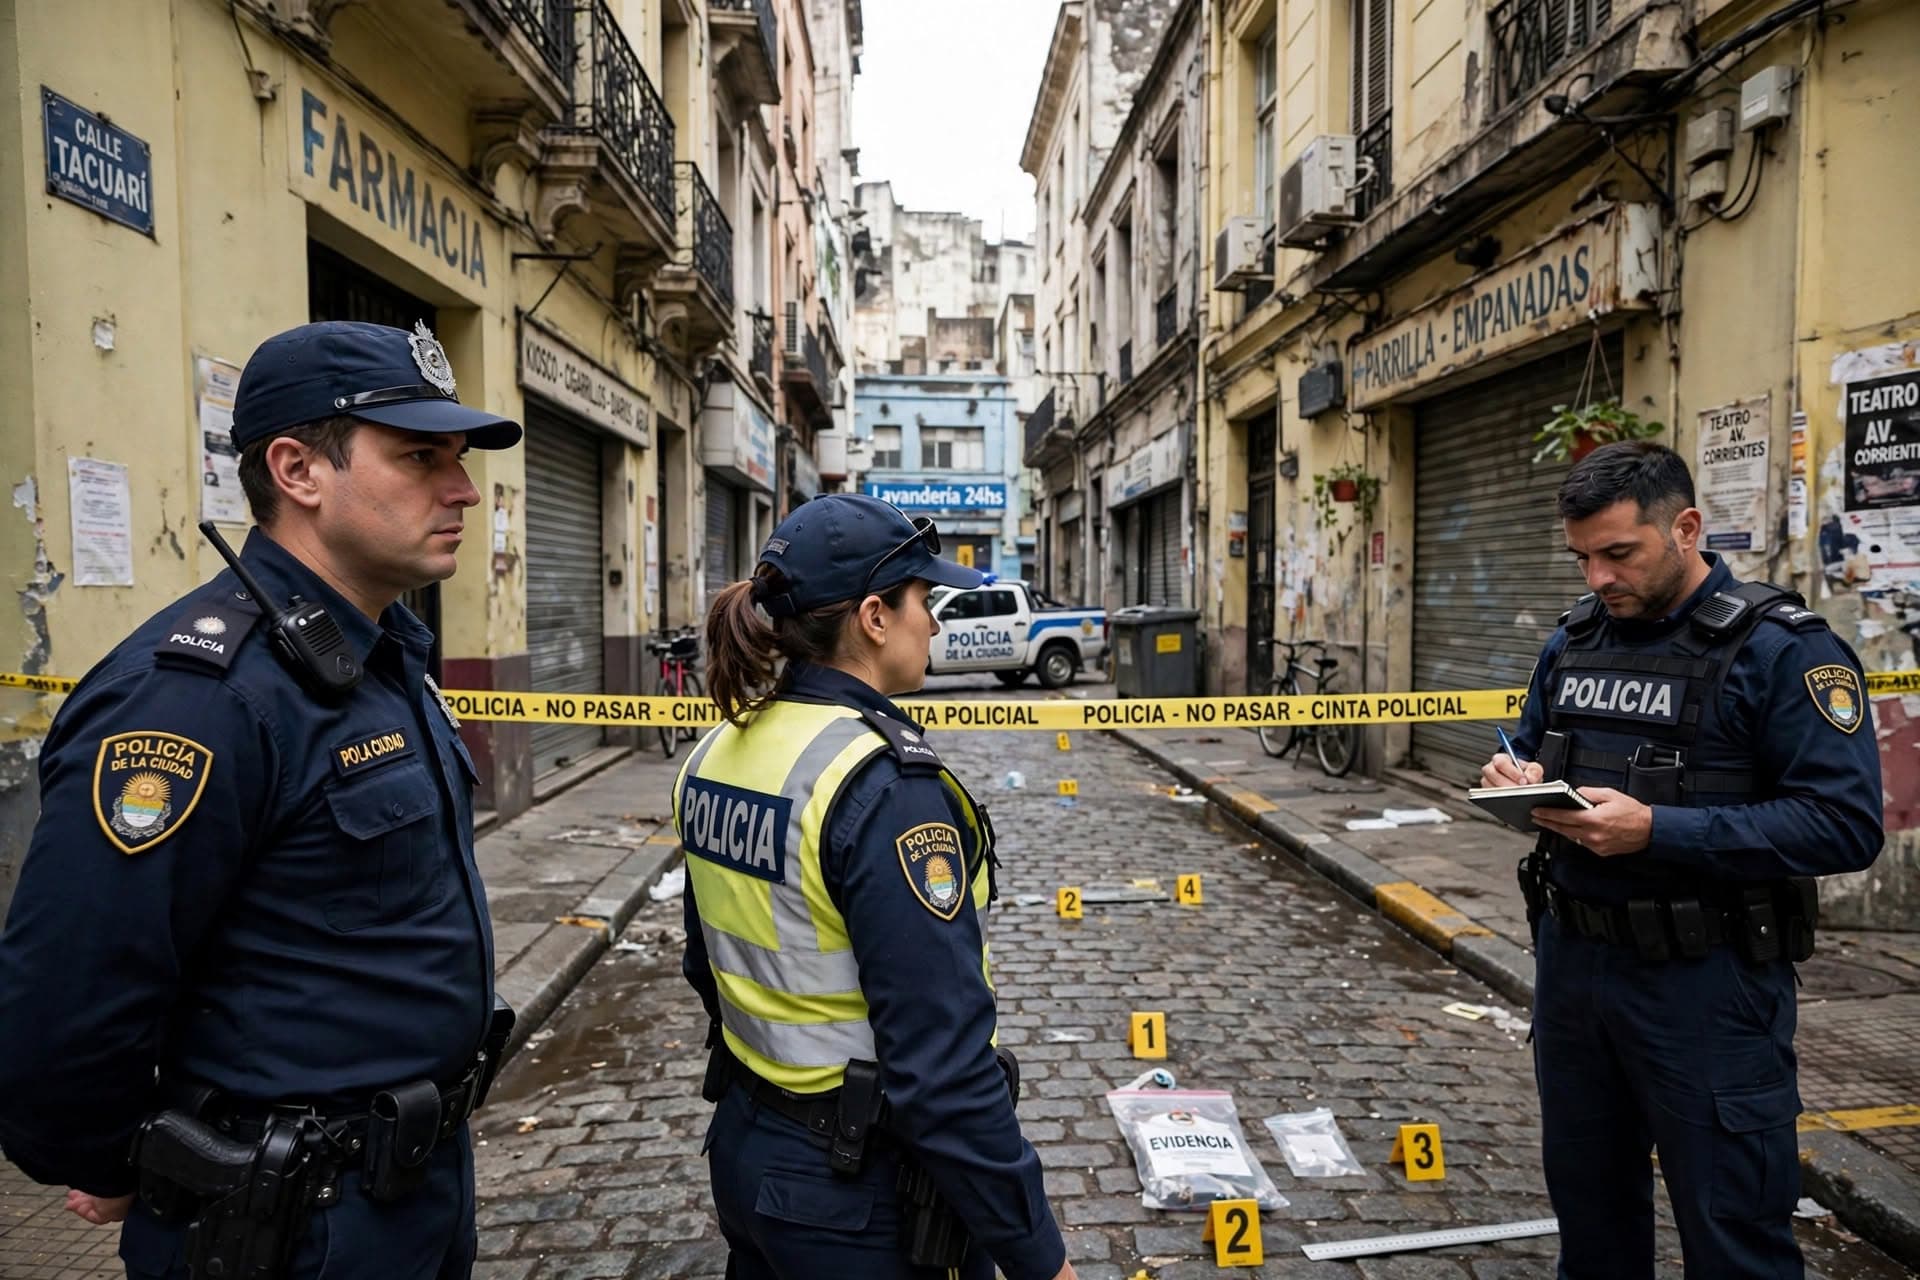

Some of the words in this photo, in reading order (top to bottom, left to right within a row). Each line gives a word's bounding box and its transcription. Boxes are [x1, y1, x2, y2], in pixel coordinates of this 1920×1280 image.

[75, 118, 123, 162] CALLE
[54, 135, 148, 213] TACUARÍ
[302, 87, 487, 289] FARMACIA
[1364, 321, 1436, 390] PARRILLA
[1453, 245, 1590, 354] EMPANADAS
[1849, 382, 1920, 415] TEATRO
[1710, 409, 1750, 431] TEATRO
[1864, 419, 1897, 446] AV.
[964, 485, 1004, 505] 24hs
[169, 633, 225, 655] POLICIA
[948, 631, 1013, 647] POLICIA
[945, 649, 959, 660] DE
[961, 649, 973, 660] LA
[975, 647, 1014, 659] CIUDAD
[546, 699, 577, 718] NO
[583, 701, 652, 720] PASAR
[672, 702, 724, 721] CINT
[1083, 703, 1166, 724] POLICIA
[1186, 703, 1216, 722] NO
[1223, 702, 1291, 721] PASAR
[1311, 700, 1372, 719] CINTA
[1378, 696, 1468, 717] POLICIAL
[1557, 676, 1673, 717] POLICIA
[945, 705, 1039, 725] POLICIAL
[114, 738, 196, 767] POLICÍA
[111, 758, 129, 771] DE
[130, 756, 147, 768] LA
[149, 757, 194, 780] CIUDAD
[684, 786, 777, 872] POLICIA
[905, 829, 954, 852] POLICIA
[1184, 878, 1195, 898] 4
[1065, 891, 1076, 913] 2
[1141, 1018, 1156, 1049] 1
[1150, 1134, 1234, 1151] EVIDENCIA
[1413, 1131, 1435, 1171] 3
[1225, 1207, 1251, 1254] 2
